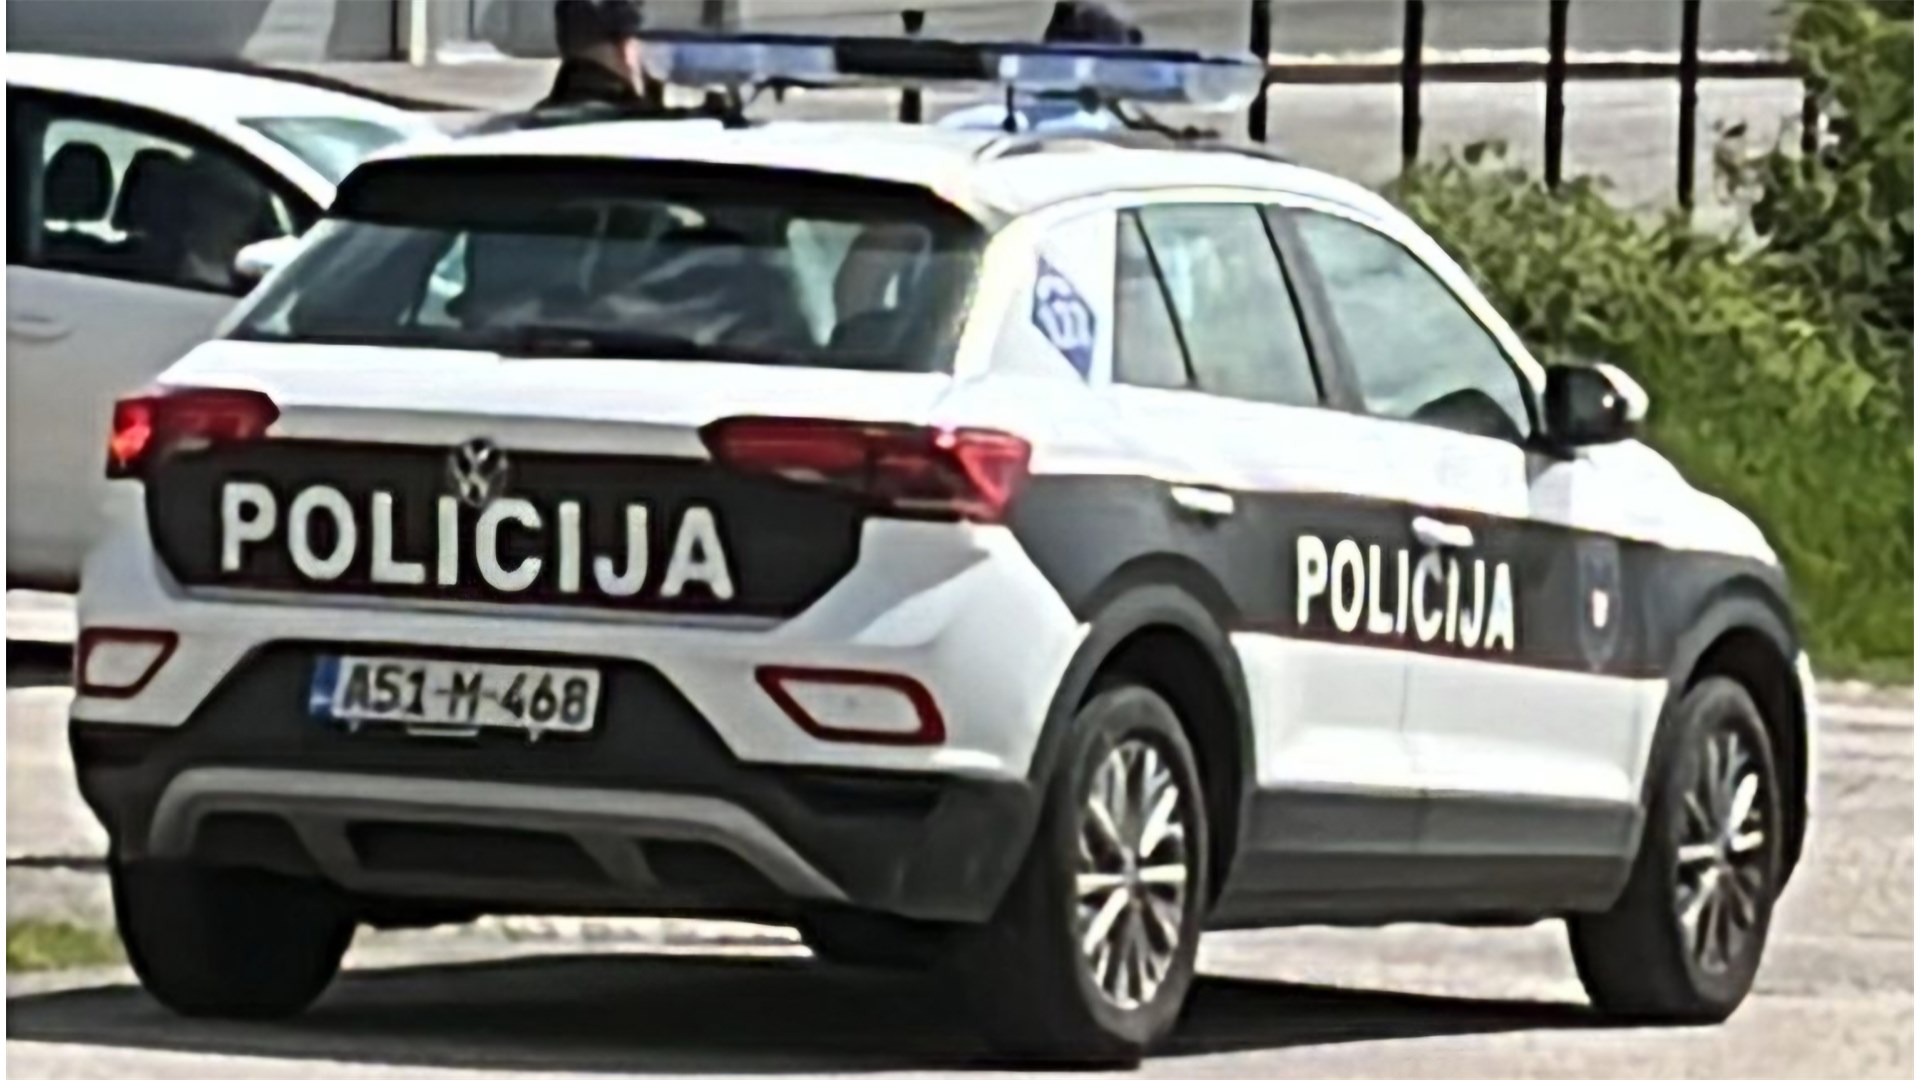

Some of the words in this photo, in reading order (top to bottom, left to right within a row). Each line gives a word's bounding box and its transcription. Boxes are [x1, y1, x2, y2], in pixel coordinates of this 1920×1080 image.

[221, 482, 734, 599] POLICIJA
[1297, 535, 1514, 651] POLICIJA
[342, 663, 590, 725] A51-M-468
